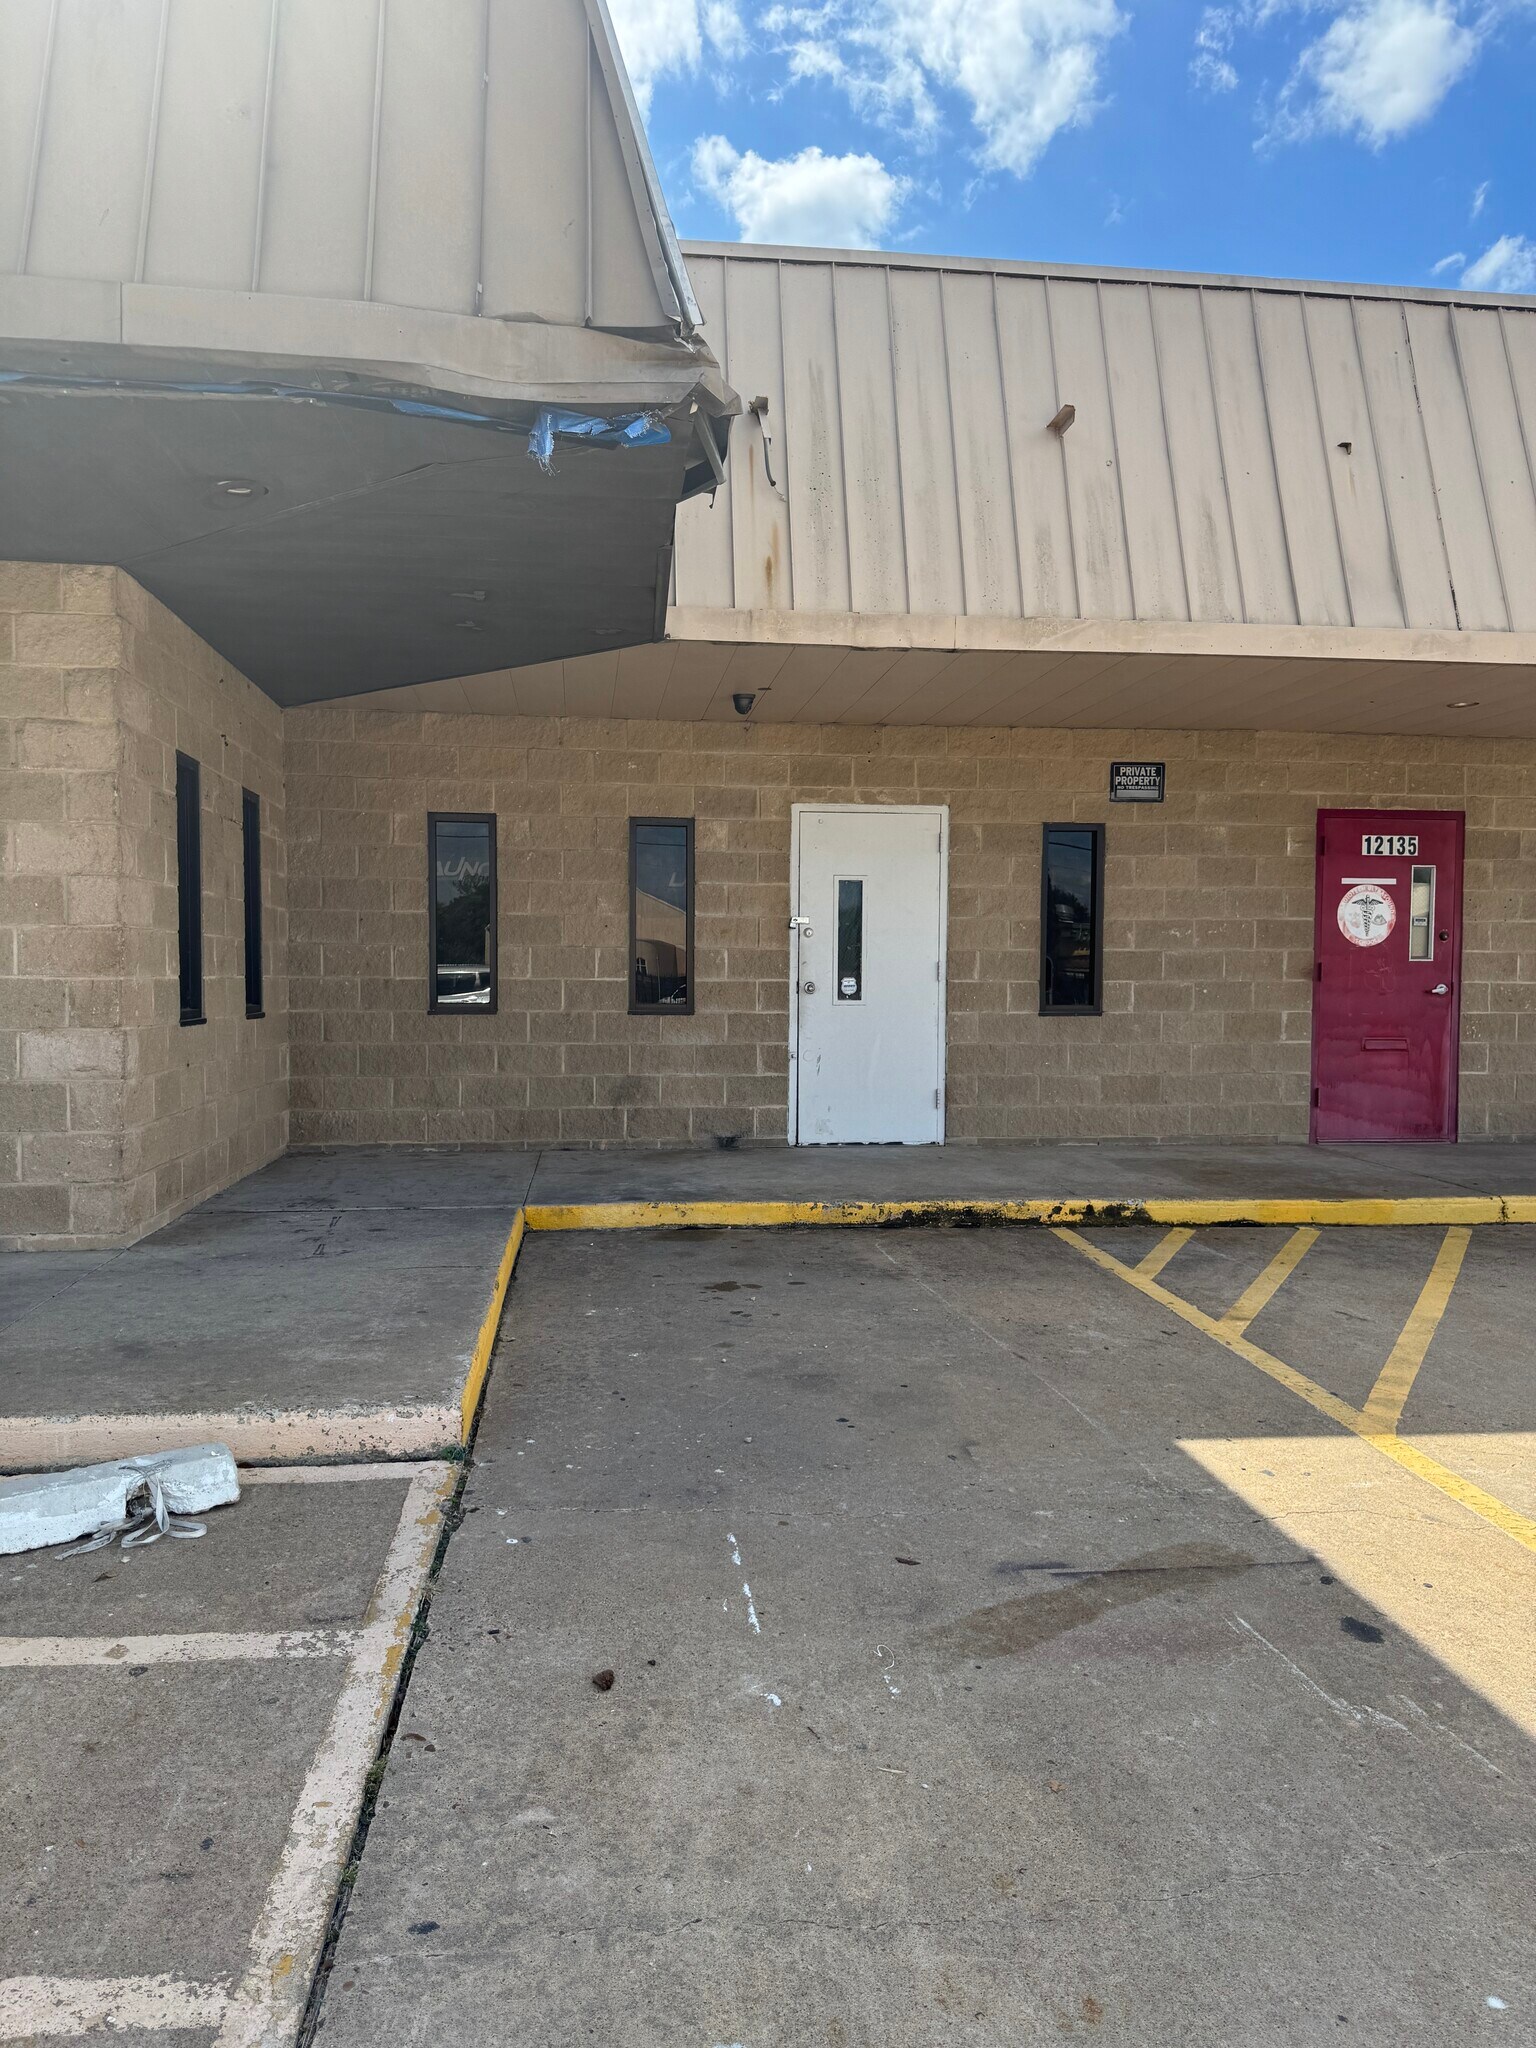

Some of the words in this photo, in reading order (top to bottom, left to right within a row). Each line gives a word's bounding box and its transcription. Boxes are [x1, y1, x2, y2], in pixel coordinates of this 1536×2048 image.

[1120, 766, 1156, 776] PRIVATE
[1115, 776, 1160, 785] PROPERTY
[1364, 836, 1417, 855] 12135
